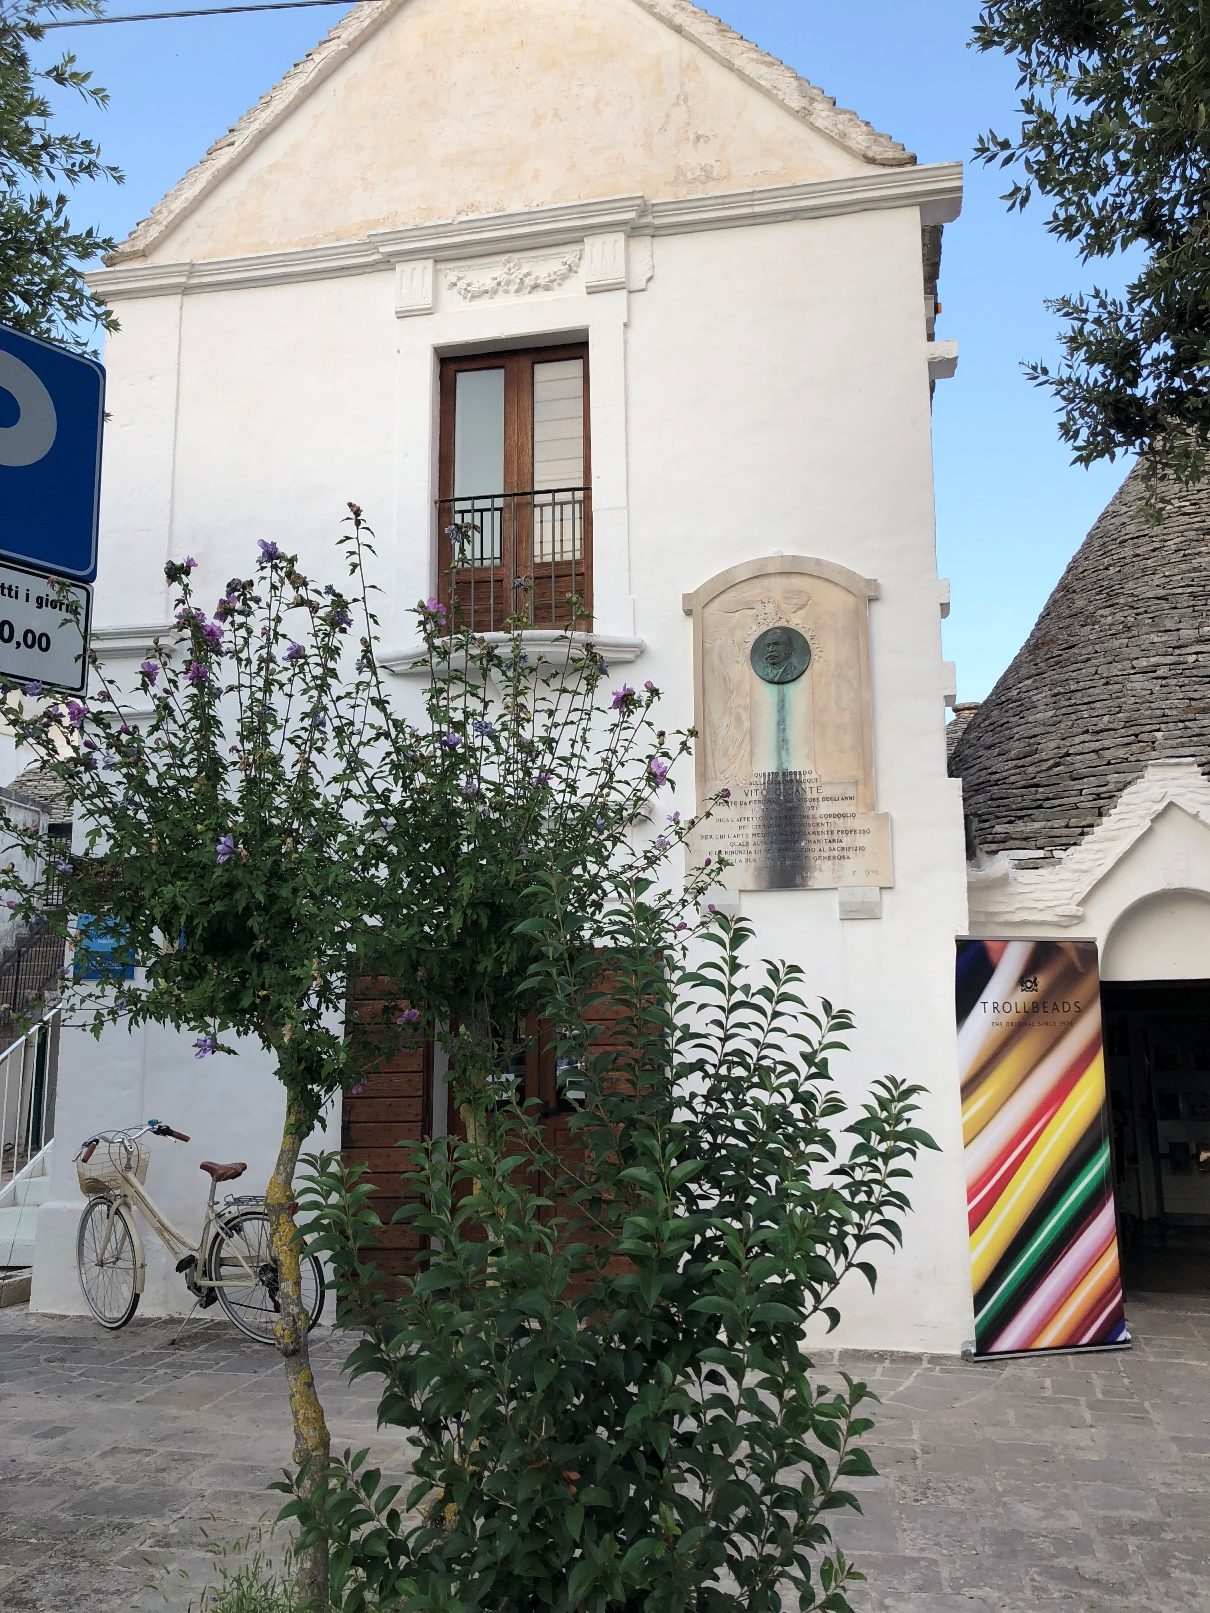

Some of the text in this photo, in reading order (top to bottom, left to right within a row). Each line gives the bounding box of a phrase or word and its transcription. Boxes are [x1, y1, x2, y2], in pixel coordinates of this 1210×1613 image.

[25, 588, 30, 603] i
[35, 593, 79, 614] giorn
[743, 788, 768, 797] VITO
[980, 1001, 1082, 1014] TROLLBEADS
